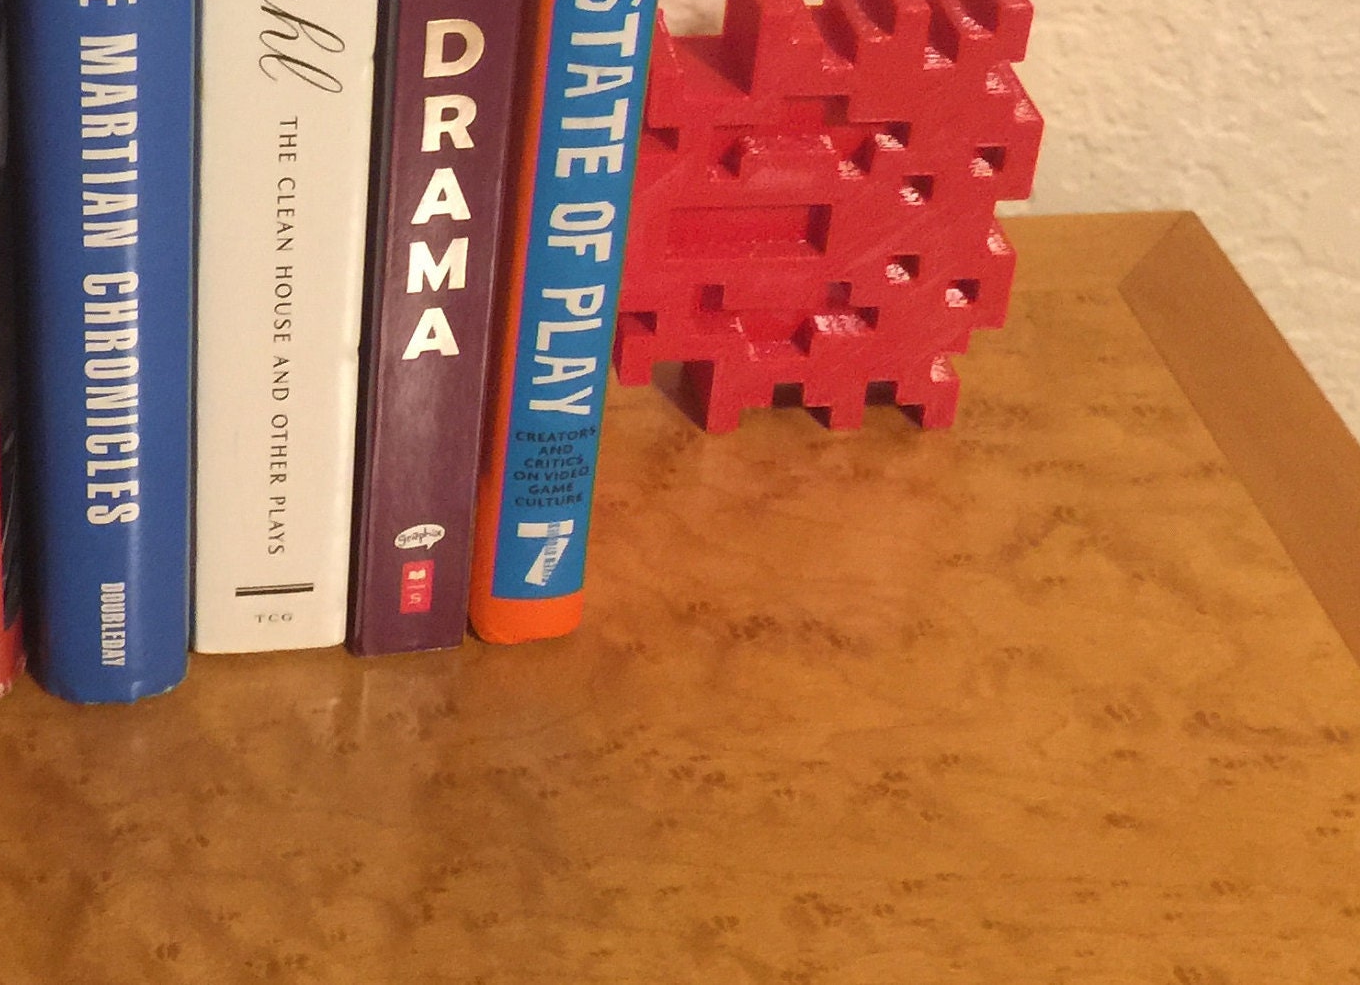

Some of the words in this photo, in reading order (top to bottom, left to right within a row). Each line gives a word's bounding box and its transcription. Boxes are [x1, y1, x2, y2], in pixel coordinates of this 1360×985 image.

[79, 33, 138, 248] MARTIAN
[279, 115, 298, 163] THE
[274, 176, 296, 252] CLEAN
[402, 18, 486, 361] DRAMA
[547, 201, 616, 263] OF
[272, 265, 294, 343] HOUSE
[271, 355, 292, 402] AND
[528, 284, 605, 415] PLAY
[82, 271, 139, 525] CHRONICLES
[268, 413, 290, 486] OTHER
[515, 426, 596, 443] CREATORS
[524, 455, 584, 469] CRITICS
[538, 444, 574, 456] AND
[513, 471, 539, 481] ON
[544, 466, 590, 482] VIDEO
[515, 493, 583, 507] CULTURE
[528, 483, 574, 495] GAME
[267, 495, 287, 556] PLAYS
[517, 519, 574, 586] 7
[100, 582, 126, 667] DOUBLEDAY
[254, 612, 293, 624] TCG
